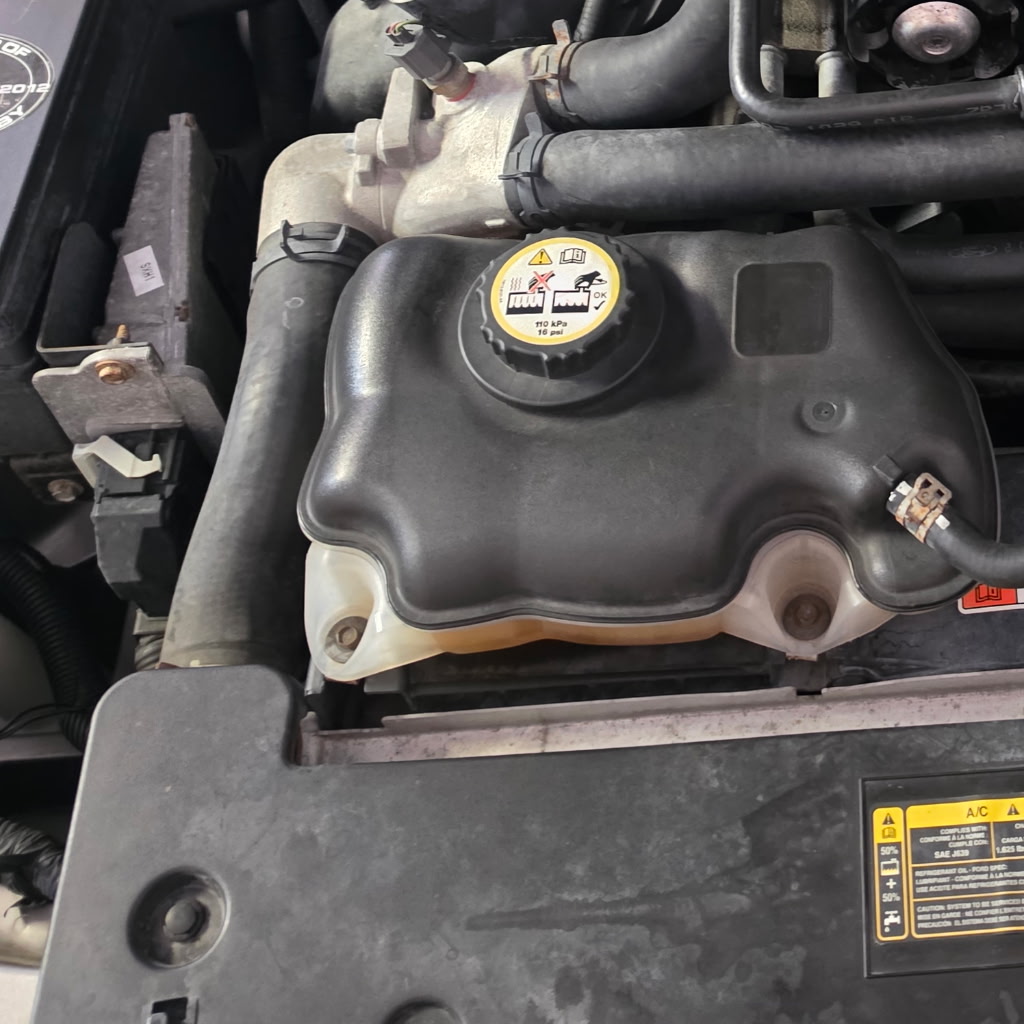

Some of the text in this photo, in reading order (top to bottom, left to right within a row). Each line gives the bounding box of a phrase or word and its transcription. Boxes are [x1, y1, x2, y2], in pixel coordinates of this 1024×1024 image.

[593, 291, 608, 299] OK
[535, 320, 568, 328] 110 kPa
[537, 328, 564, 337] 16 psi
[966, 806, 989, 819] A/C
[880, 845, 899, 856] 50%
[934, 850, 951, 859] SAE
[882, 892, 901, 903] 50%
